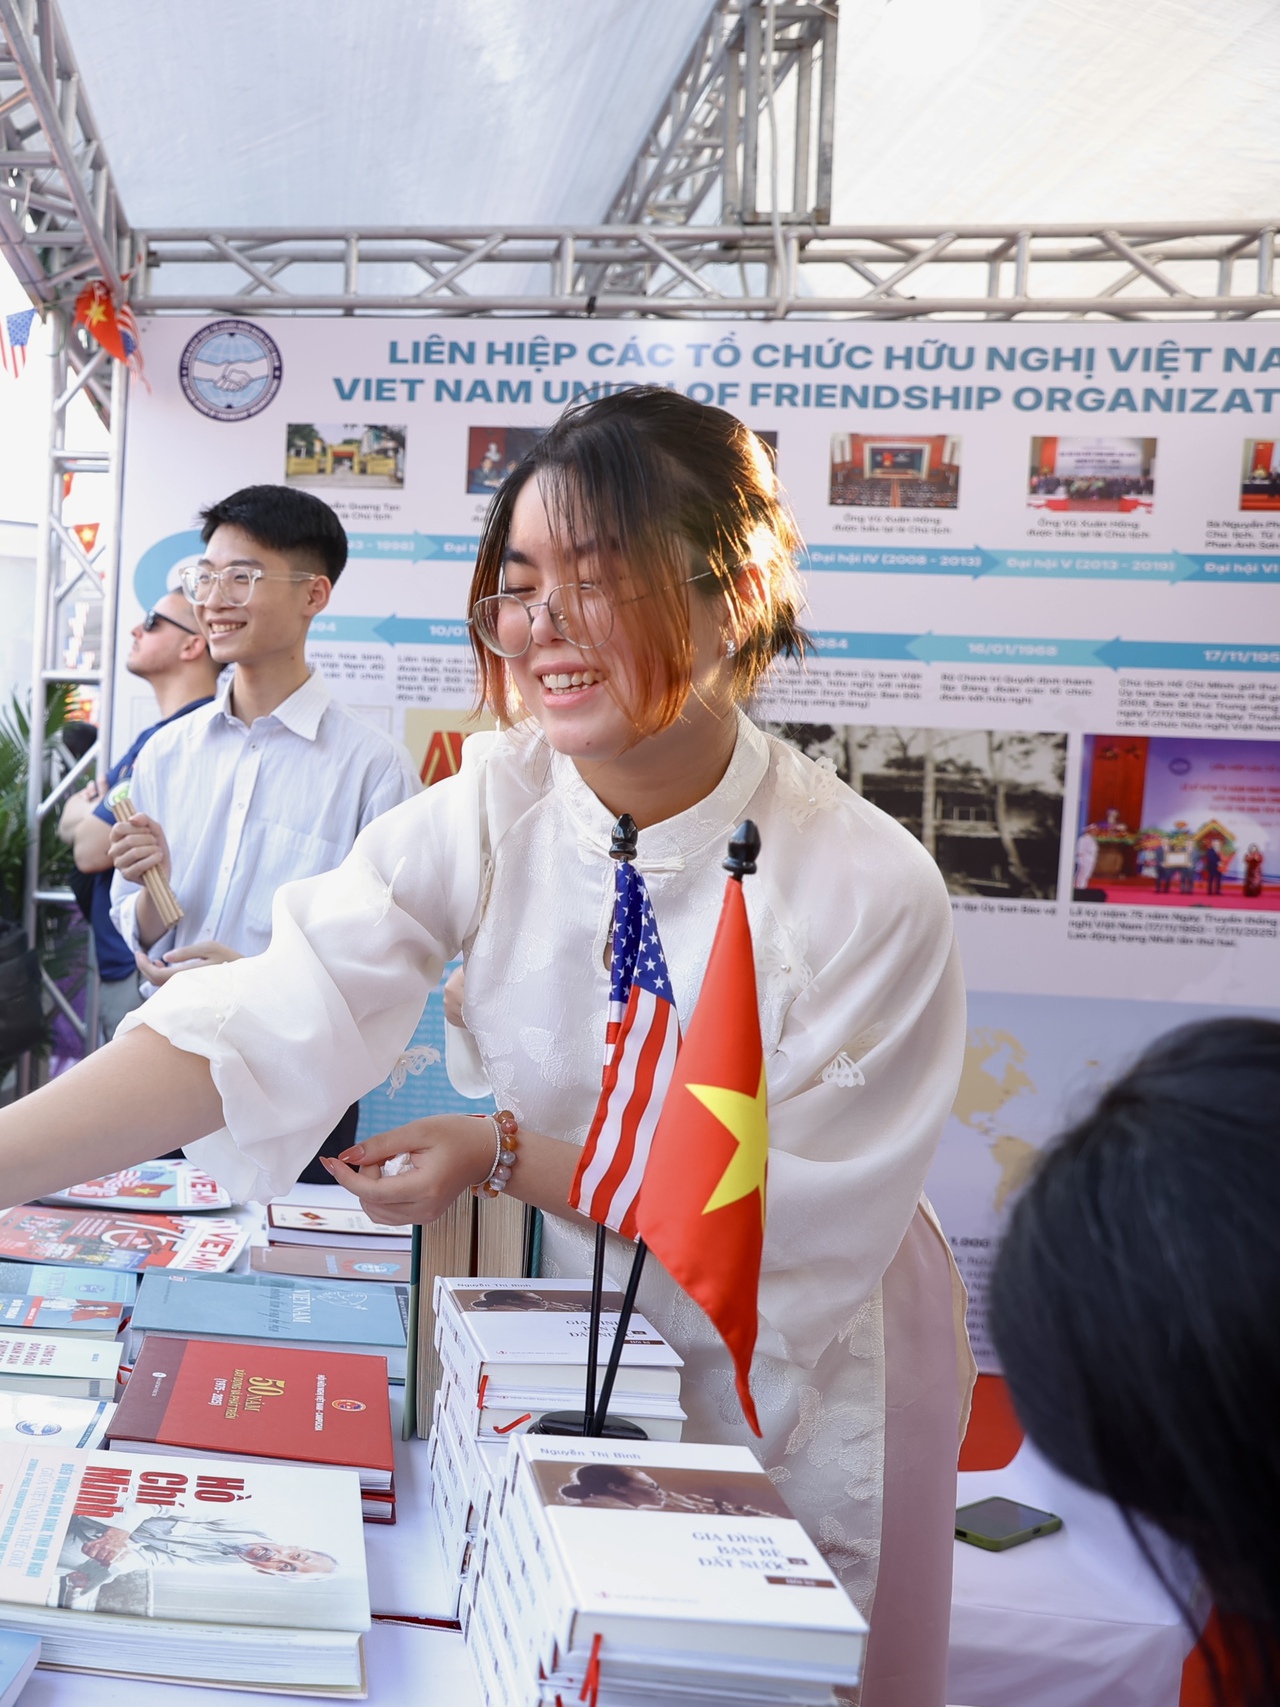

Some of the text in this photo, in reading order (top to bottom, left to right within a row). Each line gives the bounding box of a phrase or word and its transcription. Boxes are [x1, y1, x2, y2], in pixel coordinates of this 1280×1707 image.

[389, 335, 475, 364] LIÊN
[487, 335, 577, 372] HIỆP
[588, 336, 675, 367] CÁC
[684, 332, 741, 367] TỔ
[753, 338, 873, 370] CHỨC
[885, 339, 975, 370] HỮU
[987, 346, 1095, 380] NGHỊ
[1107, 341, 1213, 380] VIỆT
[333, 378, 425, 402] VIET
[435, 379, 532, 404] NAM
[686, 382, 740, 407] OF
[751, 383, 1001, 411] FRIENDSHIP
[1012, 386, 1280, 414] ORGANIZAT
[289, 1289, 315, 1324] VIỆT NAM
[243, 1375, 286, 1412] 50 NĂM
[540, 1447, 641, 1460] Nguyễn Thị Bình
[73, 1465, 132, 1519] Minh
[135, 1471, 189, 1508] Chí
[194, 1475, 252, 1504] Hồ
[692, 1531, 724, 1544] GIA
